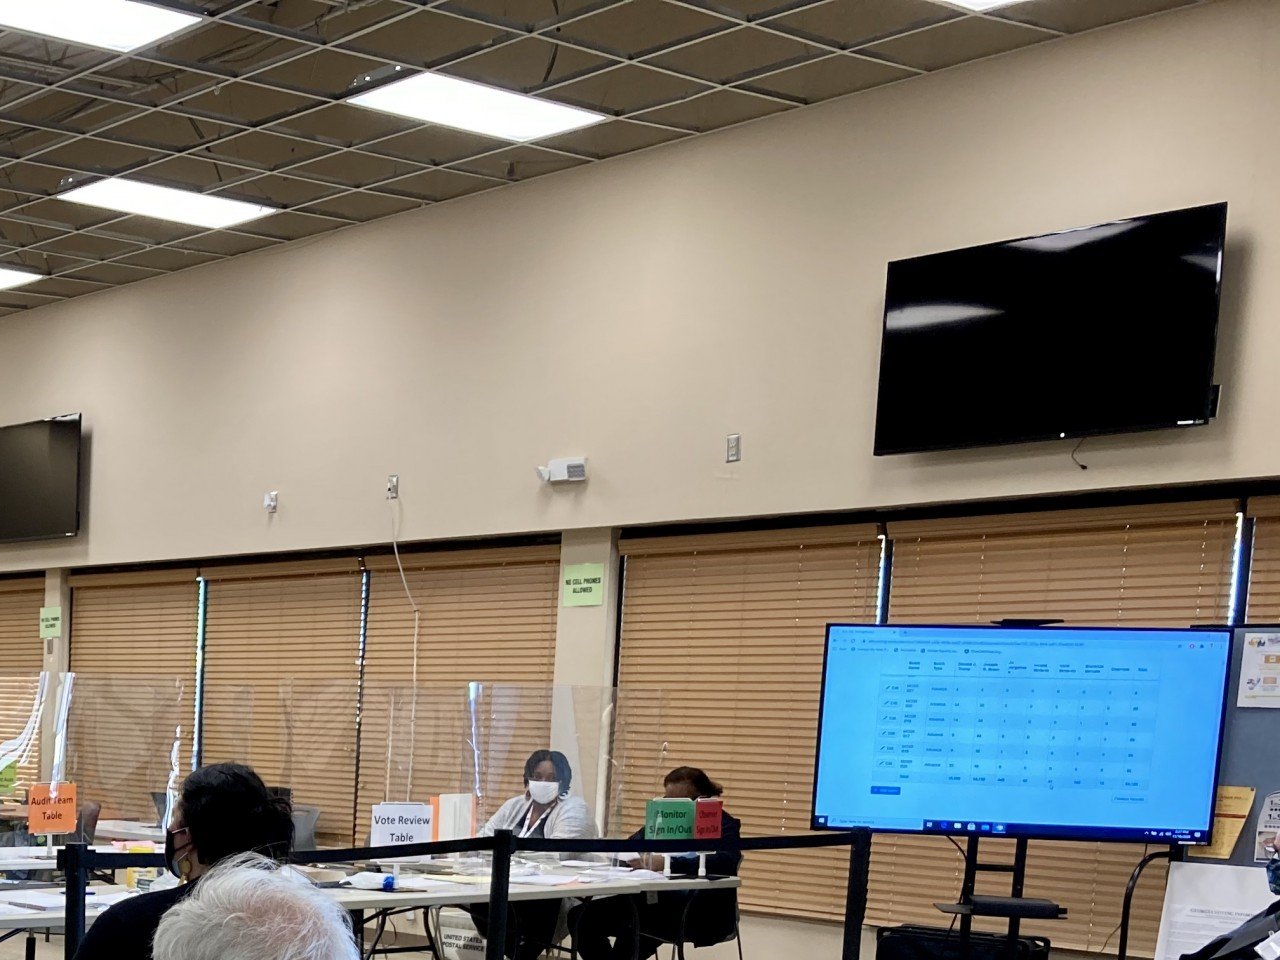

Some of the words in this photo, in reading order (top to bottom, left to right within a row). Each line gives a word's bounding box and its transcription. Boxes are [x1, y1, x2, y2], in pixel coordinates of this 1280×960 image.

[54, 797, 74, 805] Team
[42, 811, 62, 820] Table
[374, 816, 395, 824] Vote
[398, 816, 430, 824] Review
[390, 833, 414, 842] Table
